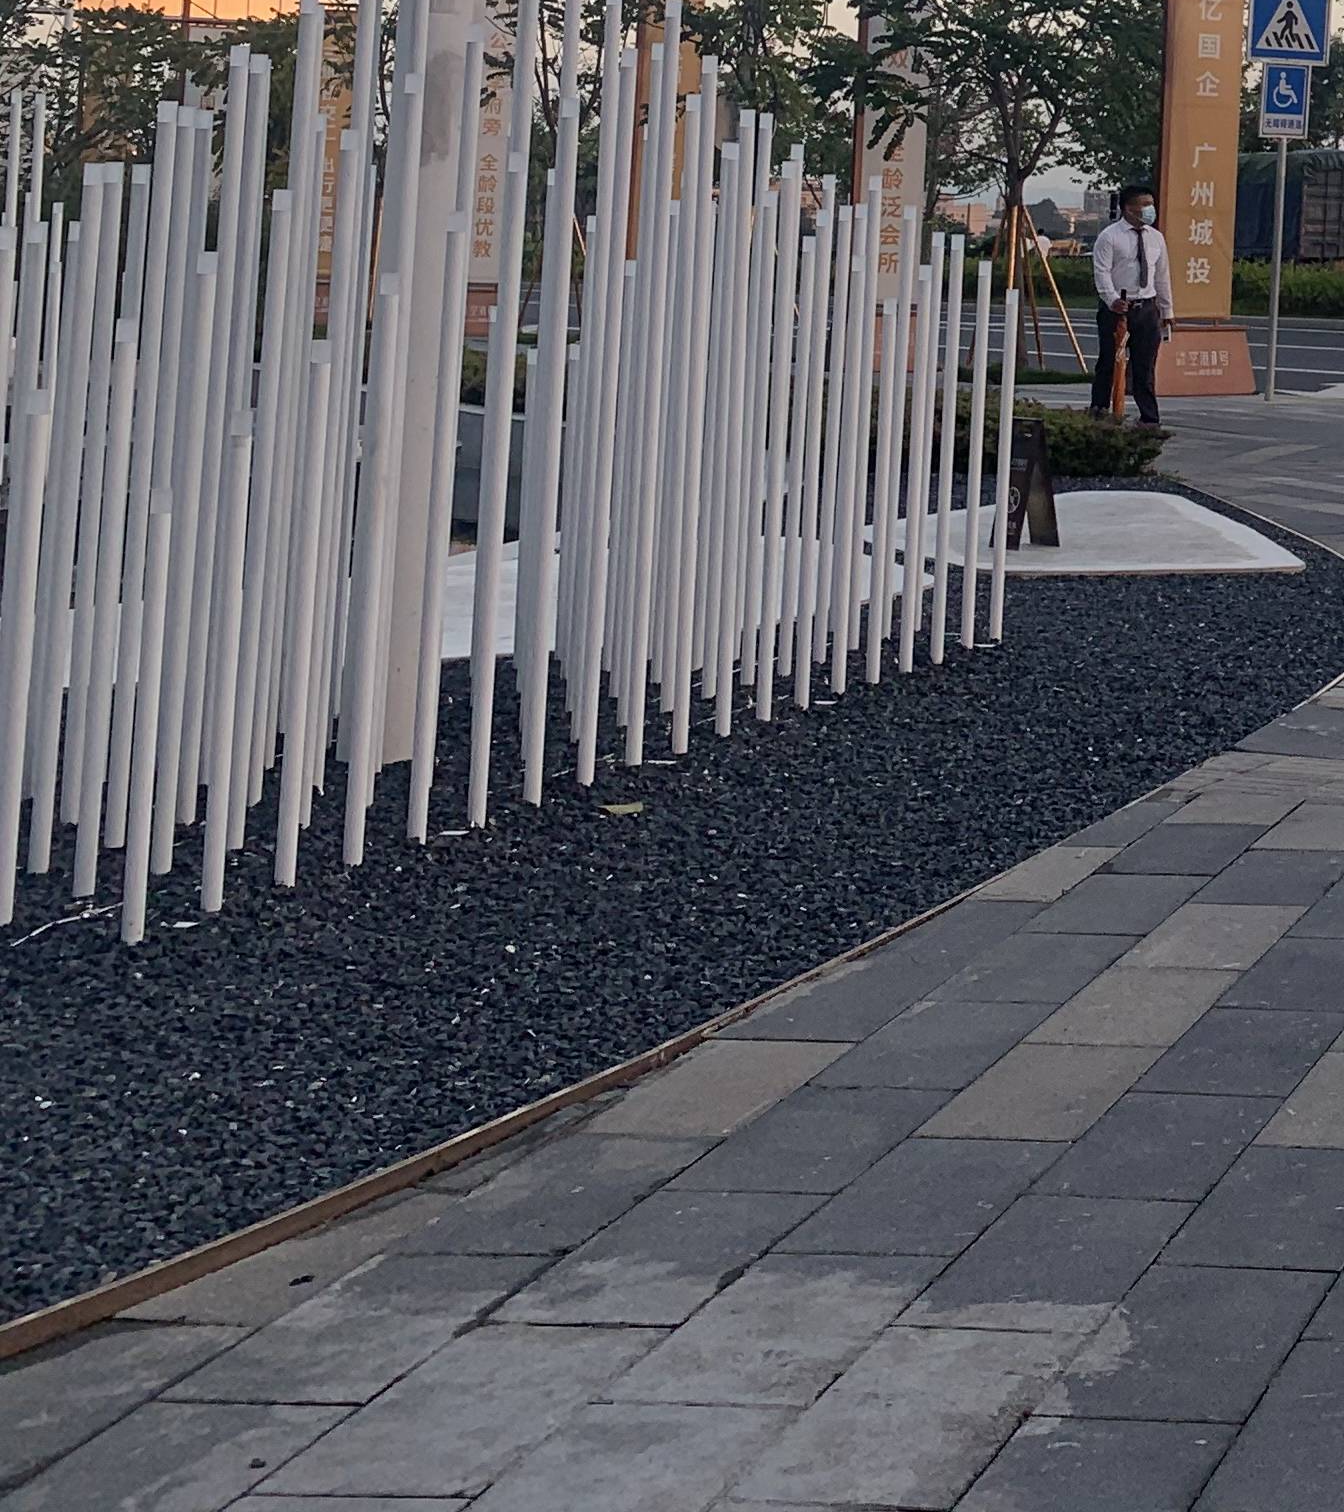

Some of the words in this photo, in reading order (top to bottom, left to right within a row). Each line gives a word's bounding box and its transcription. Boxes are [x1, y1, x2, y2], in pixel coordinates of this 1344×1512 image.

[472, 153, 499, 258] 全龄段优教
[1186, 143, 1217, 284] 广州城投
